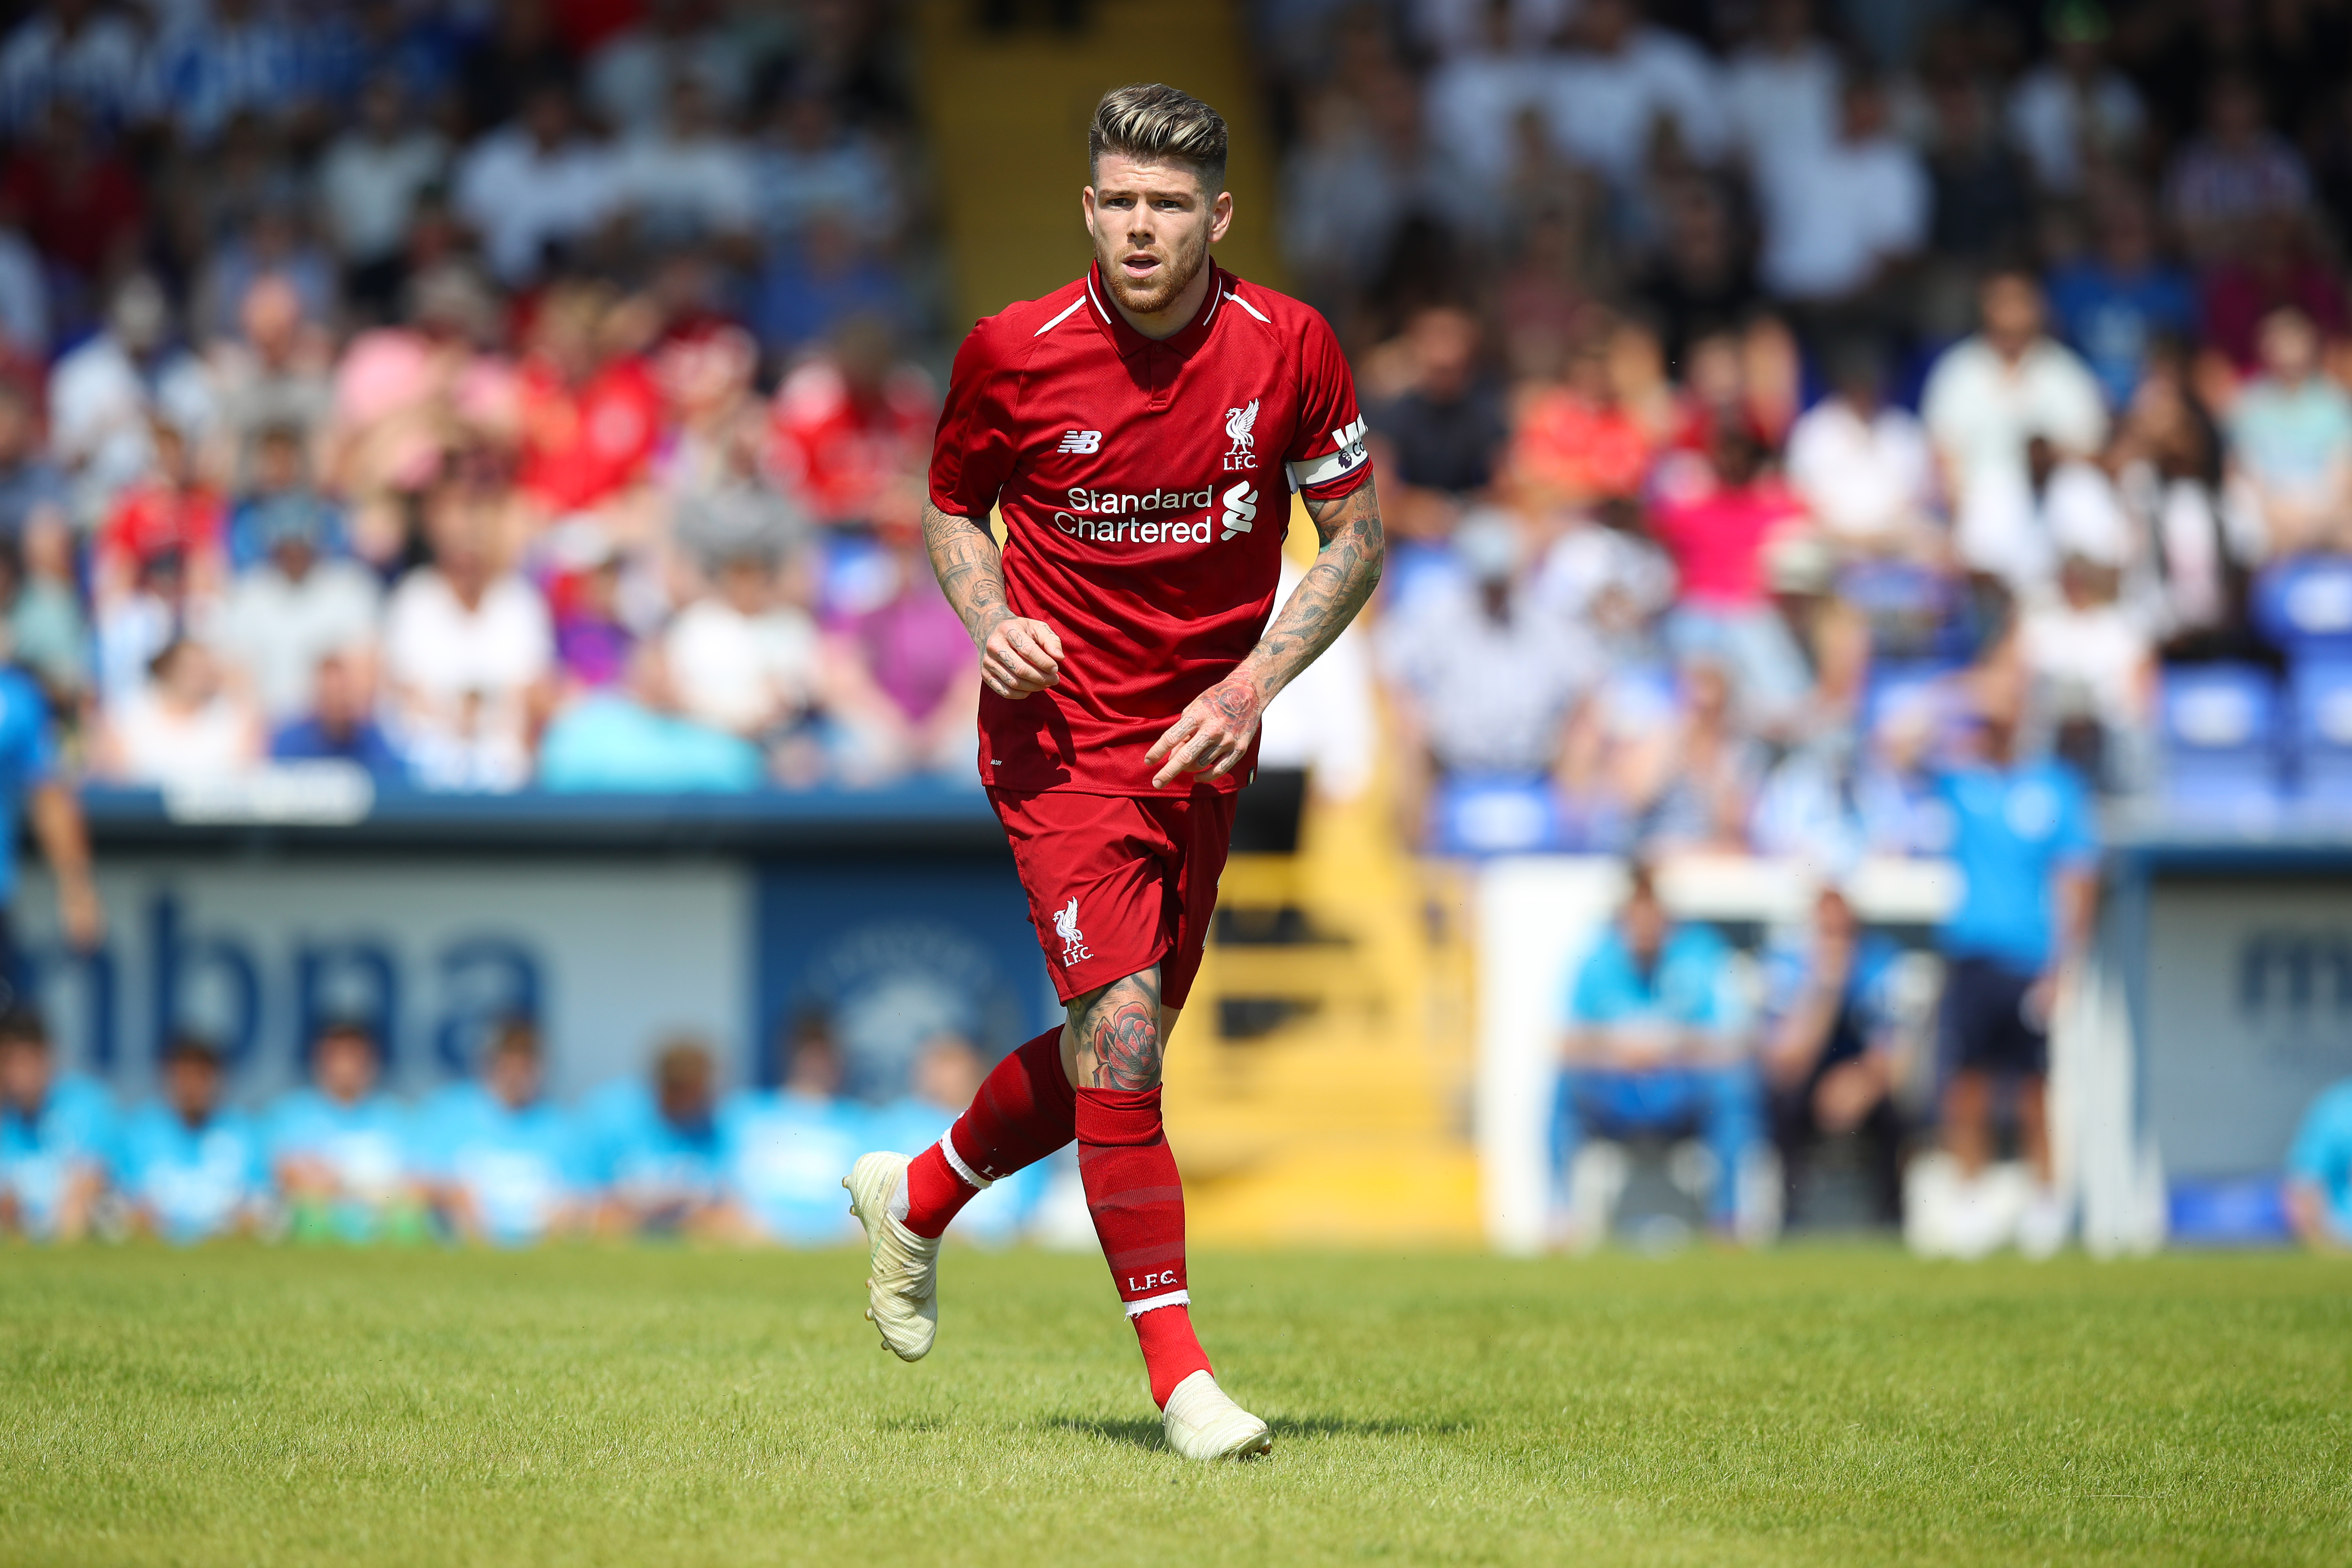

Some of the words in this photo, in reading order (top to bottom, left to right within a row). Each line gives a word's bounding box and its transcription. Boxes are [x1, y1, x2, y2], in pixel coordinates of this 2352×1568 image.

[1057, 430, 1102, 454] NB
[1223, 455, 1259, 471] L.F.C.
[1068, 484, 1213, 514] Standard
[1054, 511, 1211, 543] Chartered
[1063, 946, 1094, 968] L.F.C.
[1128, 1269, 1178, 1292] L.F.C.
